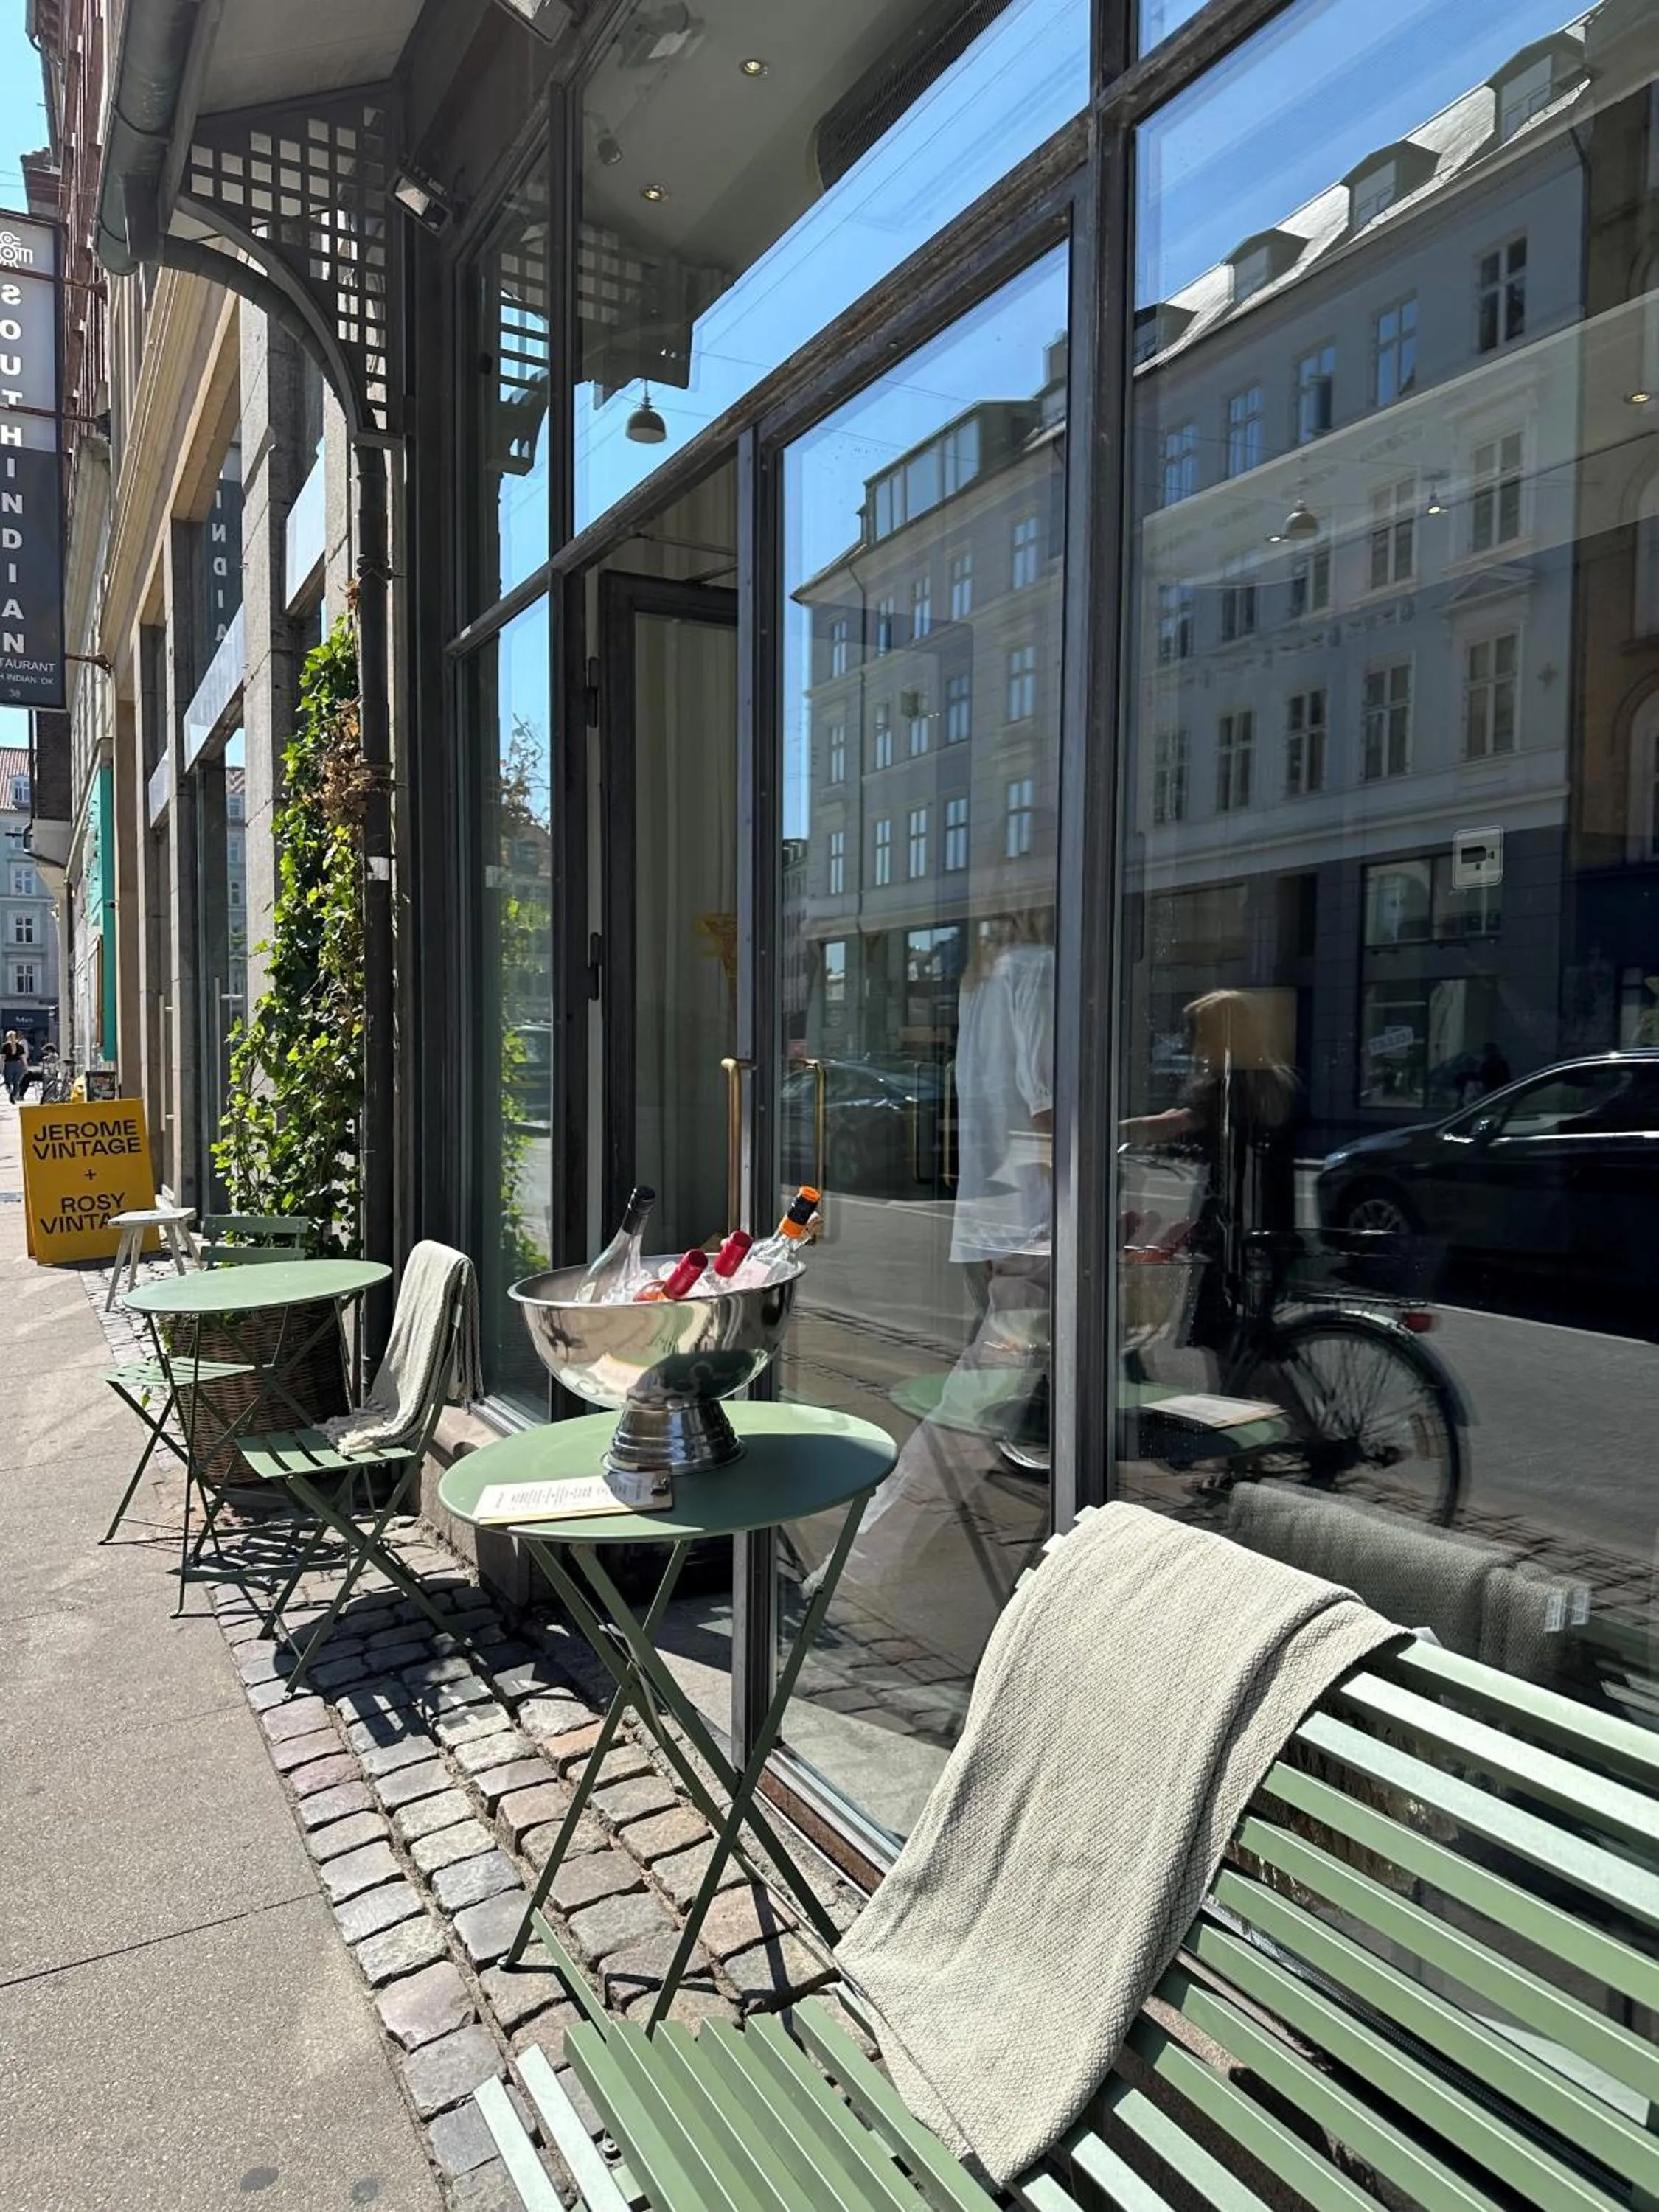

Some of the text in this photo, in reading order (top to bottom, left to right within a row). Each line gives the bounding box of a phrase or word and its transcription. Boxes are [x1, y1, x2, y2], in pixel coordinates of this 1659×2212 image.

[34, 1119, 137, 1142] JEROME
[33, 1138, 142, 1160] VINTAGE
[61, 1192, 125, 1214] ROSY
[40, 1211, 128, 1234] VINTA
